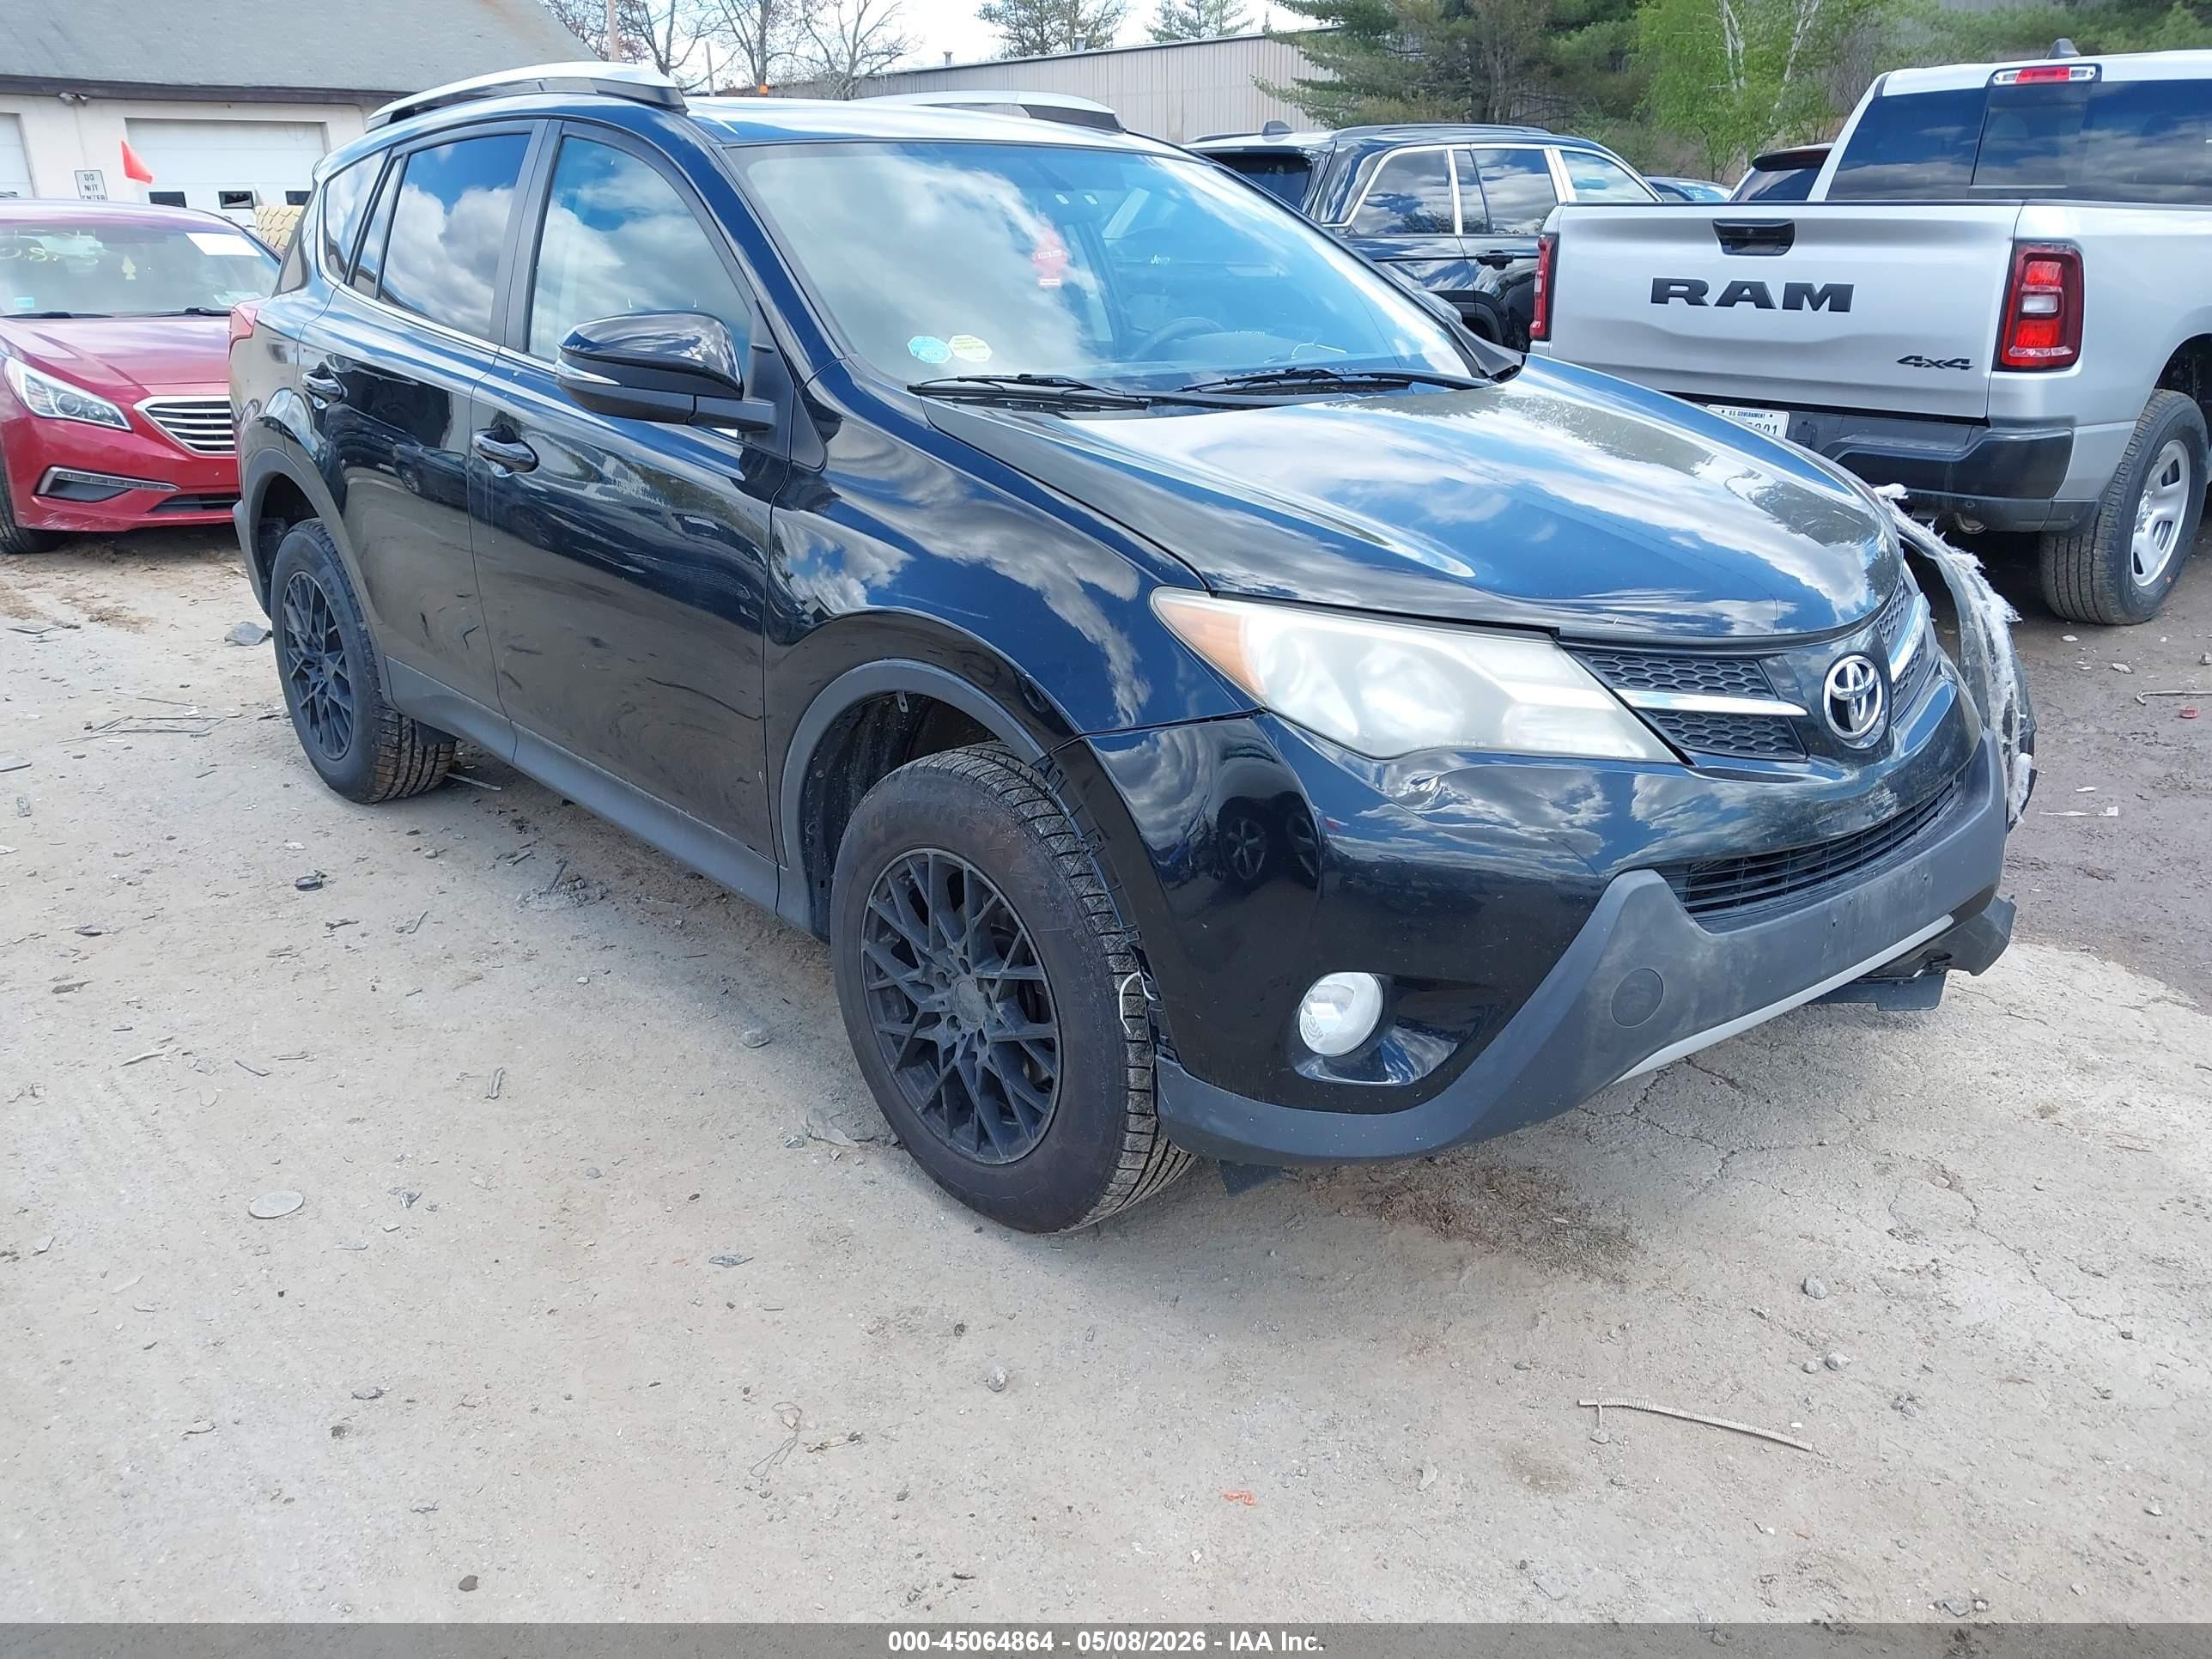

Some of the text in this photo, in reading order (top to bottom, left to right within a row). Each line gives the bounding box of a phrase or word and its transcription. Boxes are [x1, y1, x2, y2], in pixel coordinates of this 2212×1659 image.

[1650, 277, 1855, 313] RAM
[1896, 355, 1974, 370] 4x4
[1737, 410, 1766, 419] GOVERNMENT
